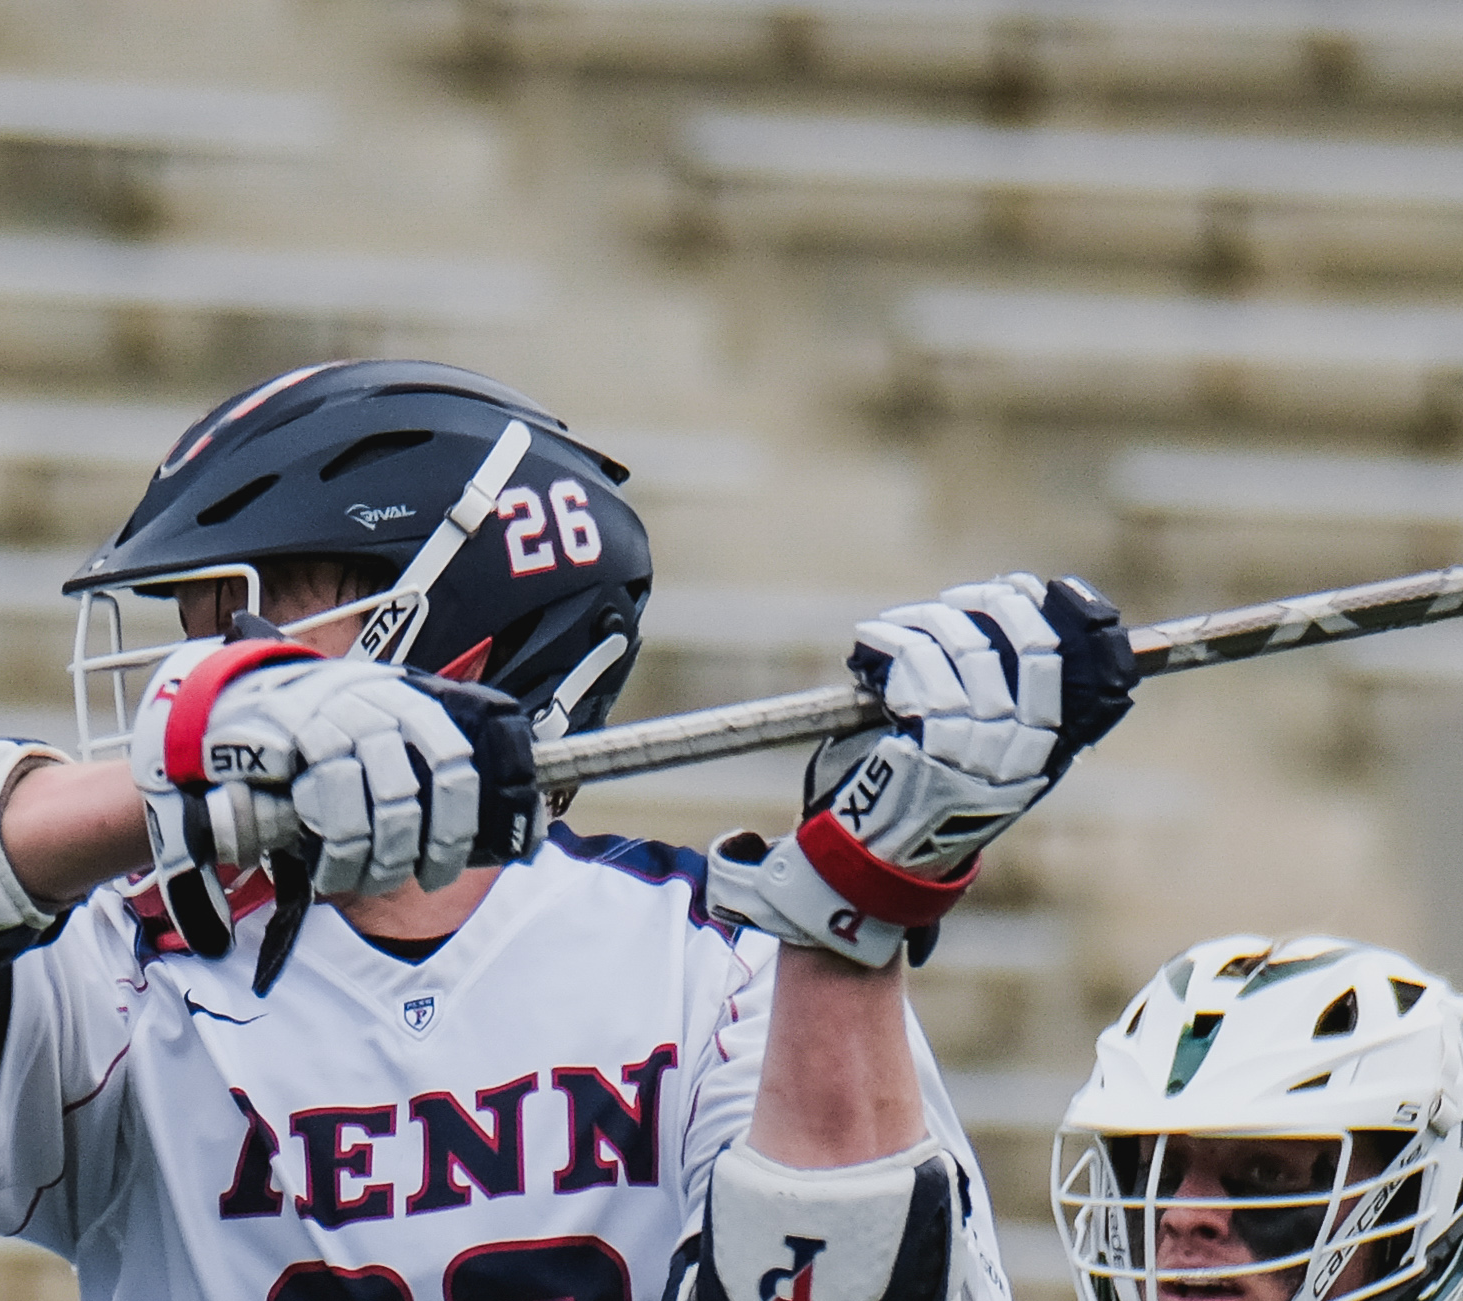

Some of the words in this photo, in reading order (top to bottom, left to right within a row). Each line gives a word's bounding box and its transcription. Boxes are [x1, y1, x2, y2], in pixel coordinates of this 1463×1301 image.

[496, 477, 603, 578] 26
[360, 600, 407, 656] STX
[210, 743, 268, 774] STX
[840, 755, 894, 832] STX
